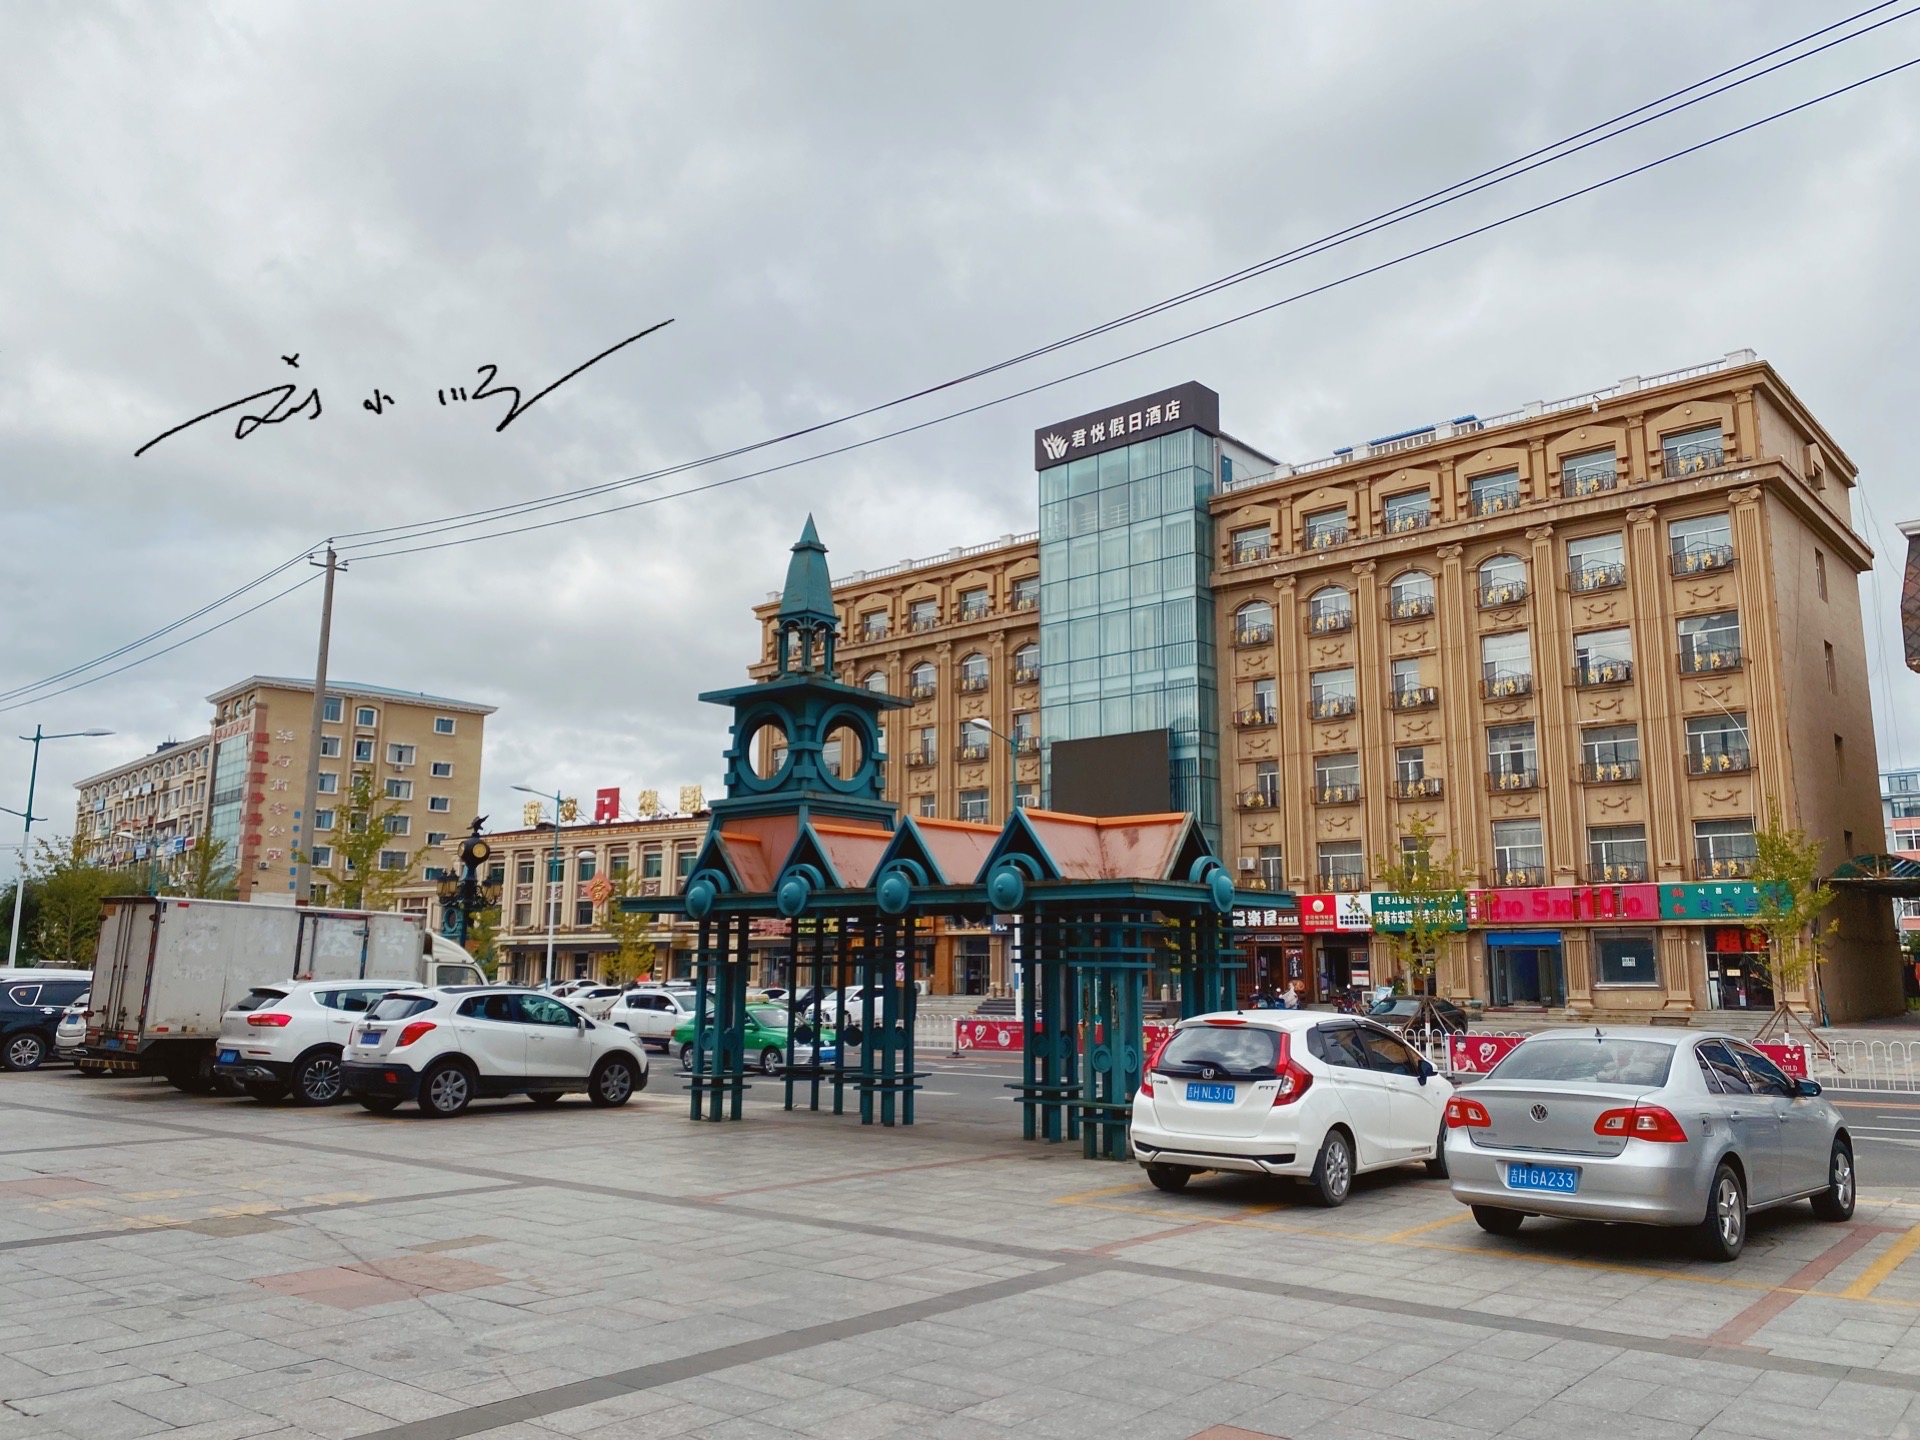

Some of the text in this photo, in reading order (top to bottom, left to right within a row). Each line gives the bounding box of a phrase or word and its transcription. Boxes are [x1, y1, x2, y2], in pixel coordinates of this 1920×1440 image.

[1071, 399, 1182, 448] 君悦假日酒店
